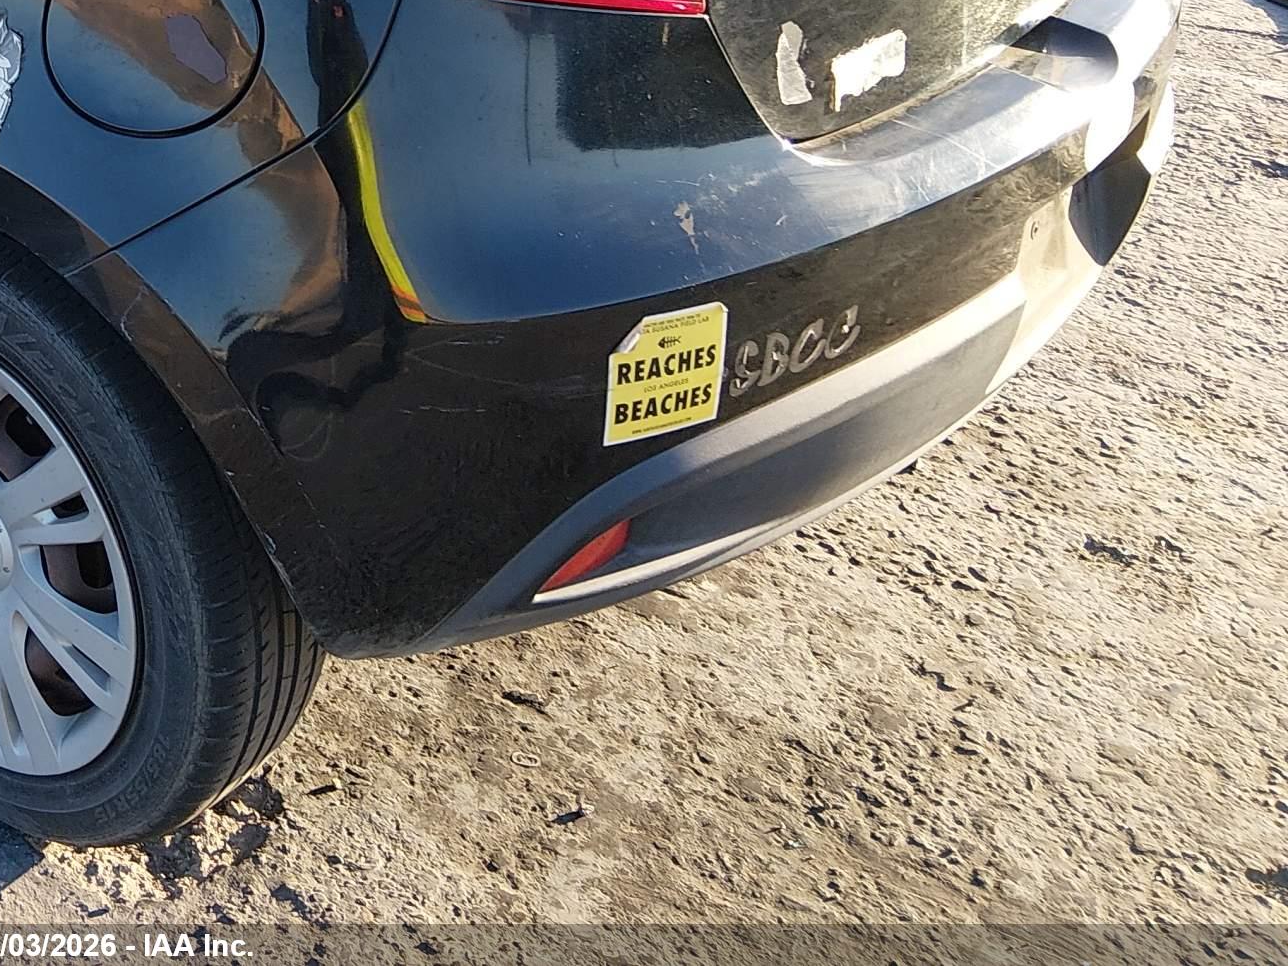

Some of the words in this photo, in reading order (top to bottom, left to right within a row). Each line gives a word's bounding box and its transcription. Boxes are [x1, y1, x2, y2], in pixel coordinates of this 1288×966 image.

[652, 323, 679, 334] SUSANA
[616, 343, 717, 386] REACHES
[643, 385, 657, 394] LOS
[658, 377, 690, 390] ANGELES
[613, 382, 713, 426] BEACHES
